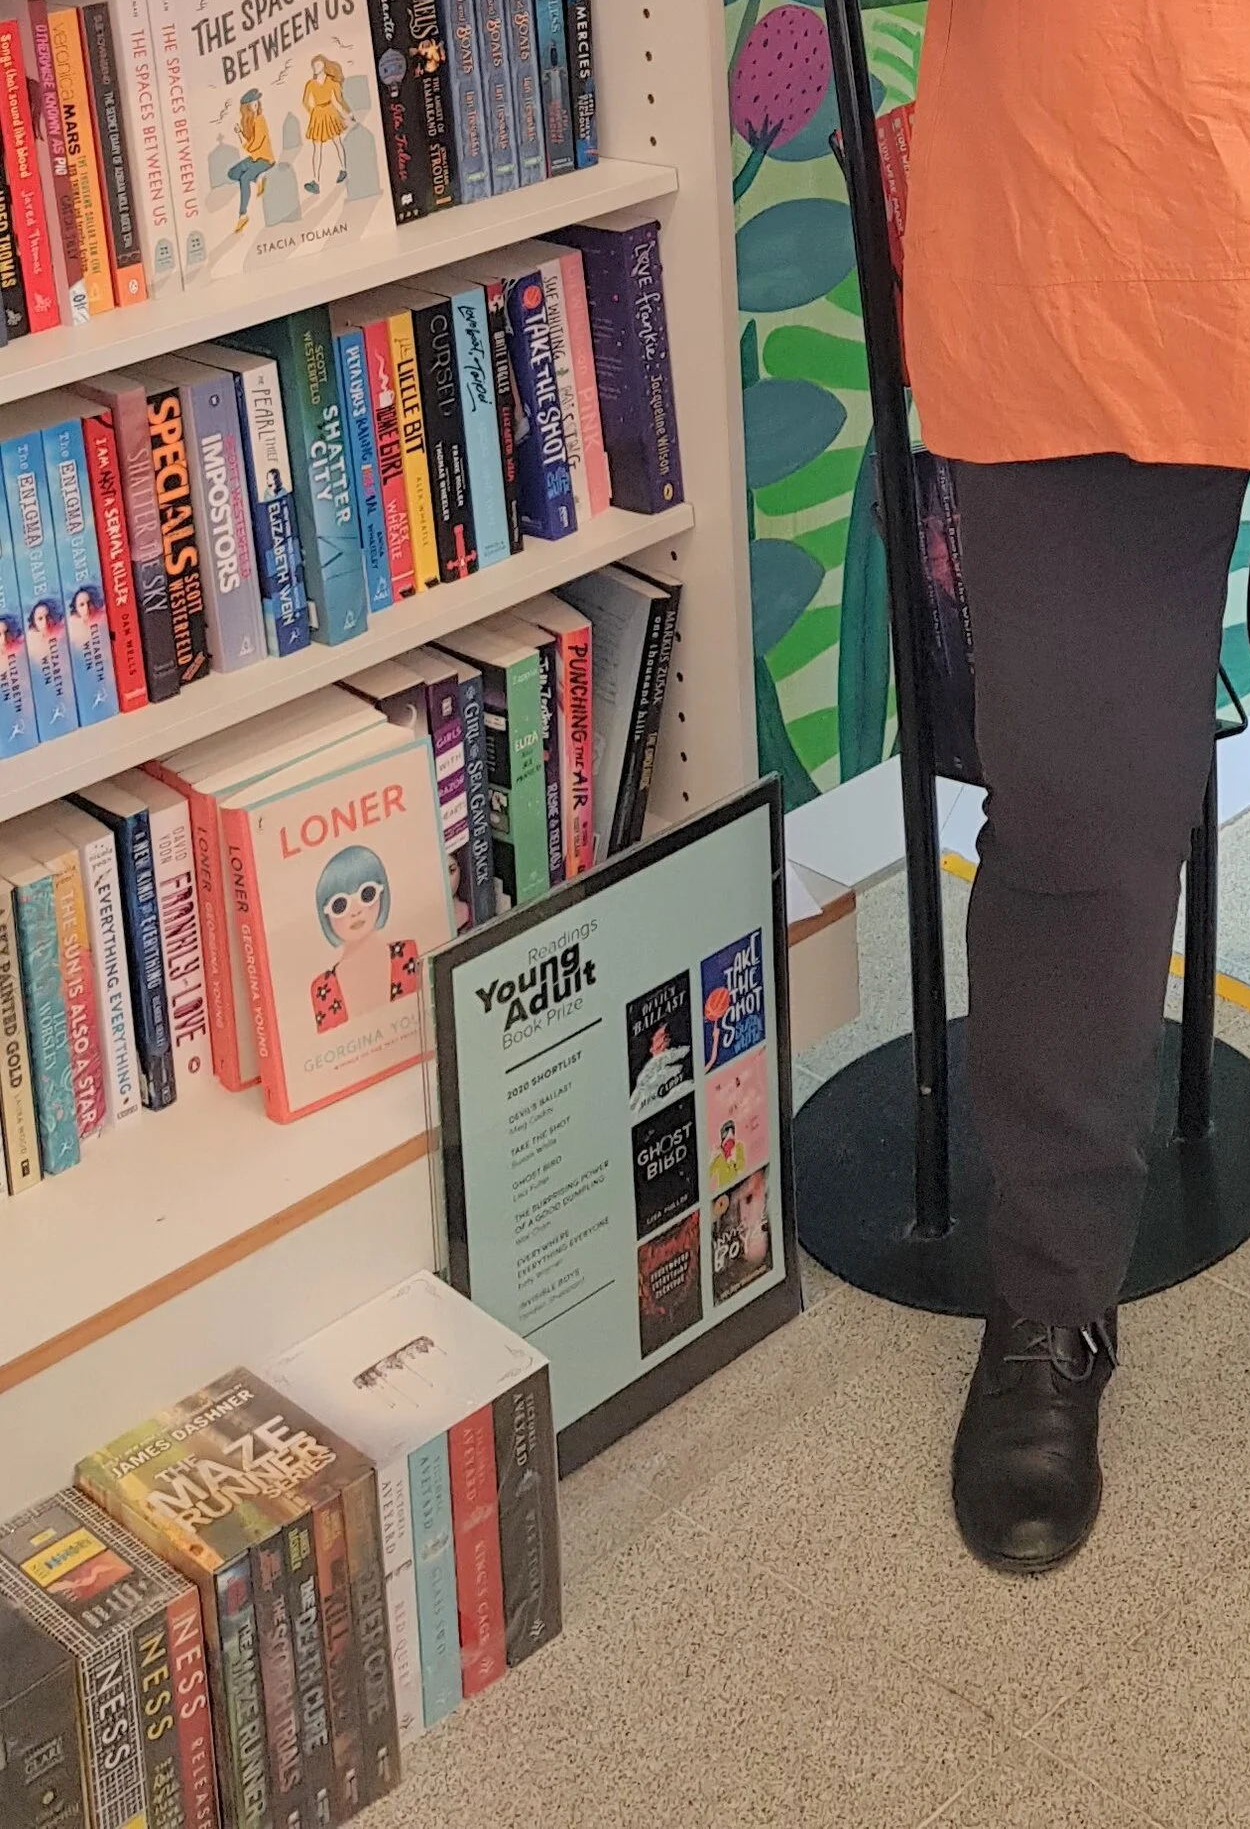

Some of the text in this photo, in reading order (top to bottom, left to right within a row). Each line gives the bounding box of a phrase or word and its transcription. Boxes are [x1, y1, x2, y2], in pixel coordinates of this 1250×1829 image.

[191, 8, 237, 57] THE
[221, 7, 320, 86] BETWEEN
[255, 221, 349, 257] STACIA TOLMAN
[523, 310, 549, 365] TAKE
[537, 400, 566, 467] SHOT
[148, 395, 199, 576] SPECIALS
[200, 431, 240, 595] IMPOSTORS
[567, 643, 588, 744] PUNCHING
[280, 782, 407, 860] LONER
[61, 890, 77, 930] THE
[64, 932, 83, 978] SUN
[528, 919, 598, 964] Readings
[69, 979, 84, 998] IS
[475, 943, 579, 1013] Young
[504, 960, 596, 1032] Adult
[70, 1002, 90, 1055] ALSO
[502, 997, 583, 1050] Book Prize
[77, 1074, 97, 1123] STAR
[506, 1051, 583, 1101] 2020 SHORTLIST
[637, 1121, 693, 1166] GHOST
[647, 1145, 688, 1183] BIRD
[111, 1438, 174, 1479] JAMES
[171, 1389, 256, 1441] DASHNER
[145, 1415, 294, 1519] MAZE
[153, 1453, 200, 1483] THE
[172, 1431, 332, 1534] RUNNER
[262, 1451, 337, 1499] SERIES
